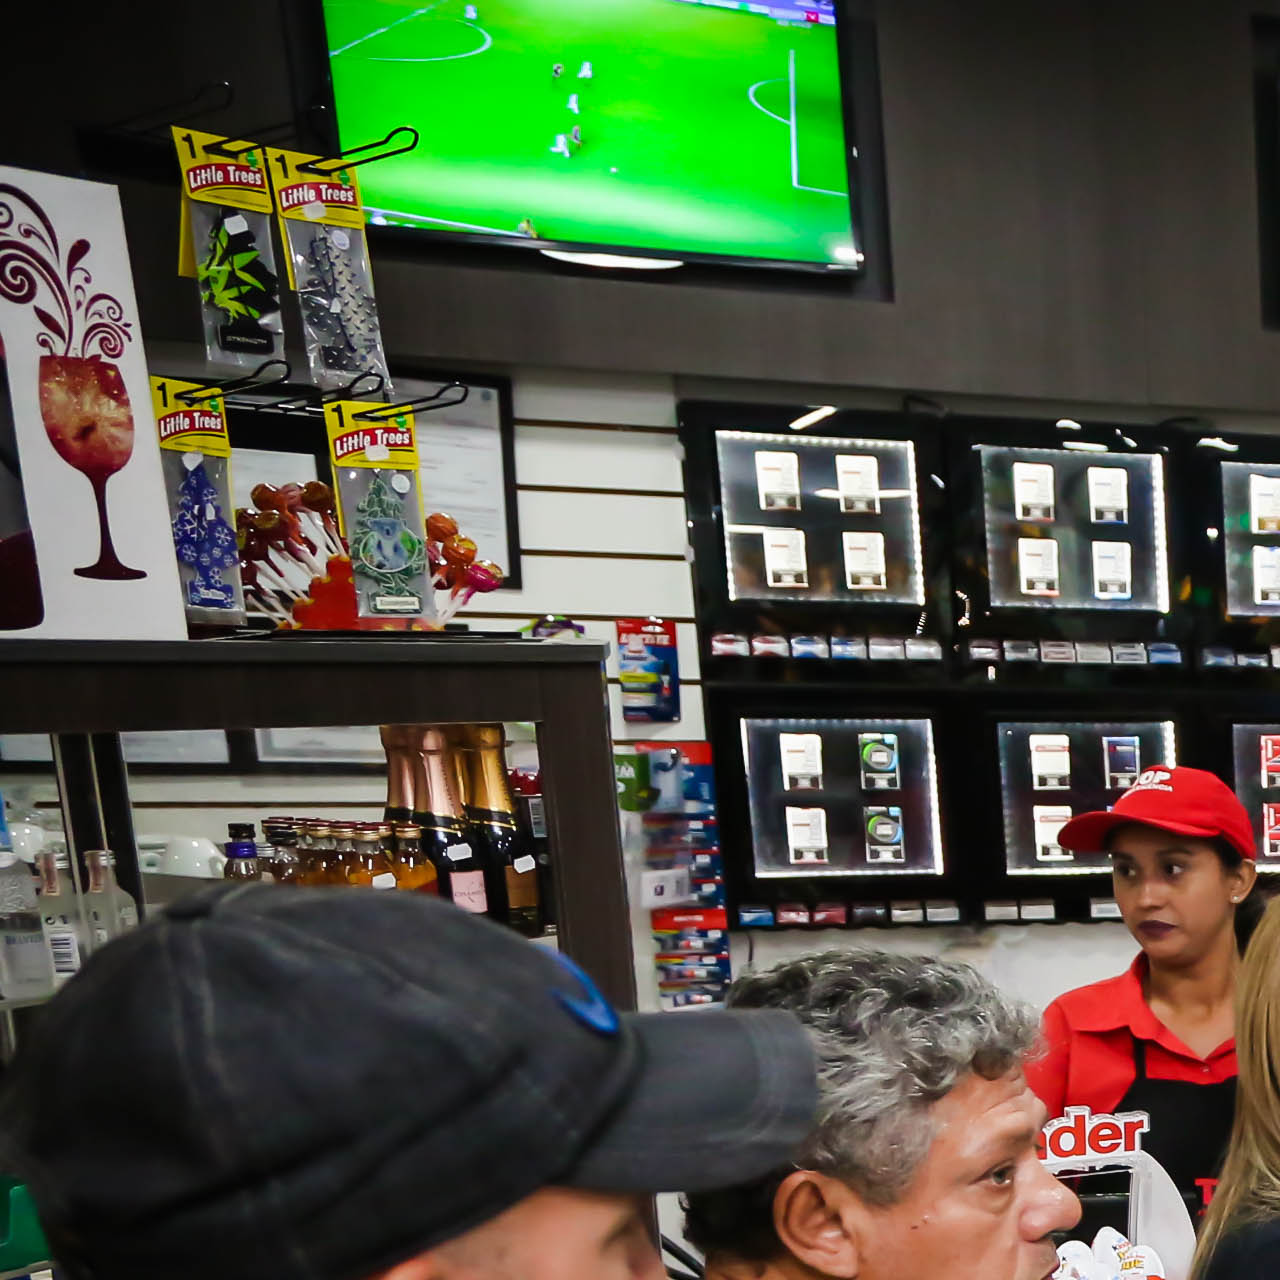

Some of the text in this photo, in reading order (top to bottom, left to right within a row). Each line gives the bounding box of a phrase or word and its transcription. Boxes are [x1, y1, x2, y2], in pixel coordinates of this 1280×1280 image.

[189, 166, 262, 188] Little Trees
[281, 184, 354, 207] Little Trees
[160, 413, 222, 437] Little Trees
[335, 429, 410, 457] Little Trees
[1131, 770, 1172, 786] OP
[1036, 1114, 1144, 1161] nder
